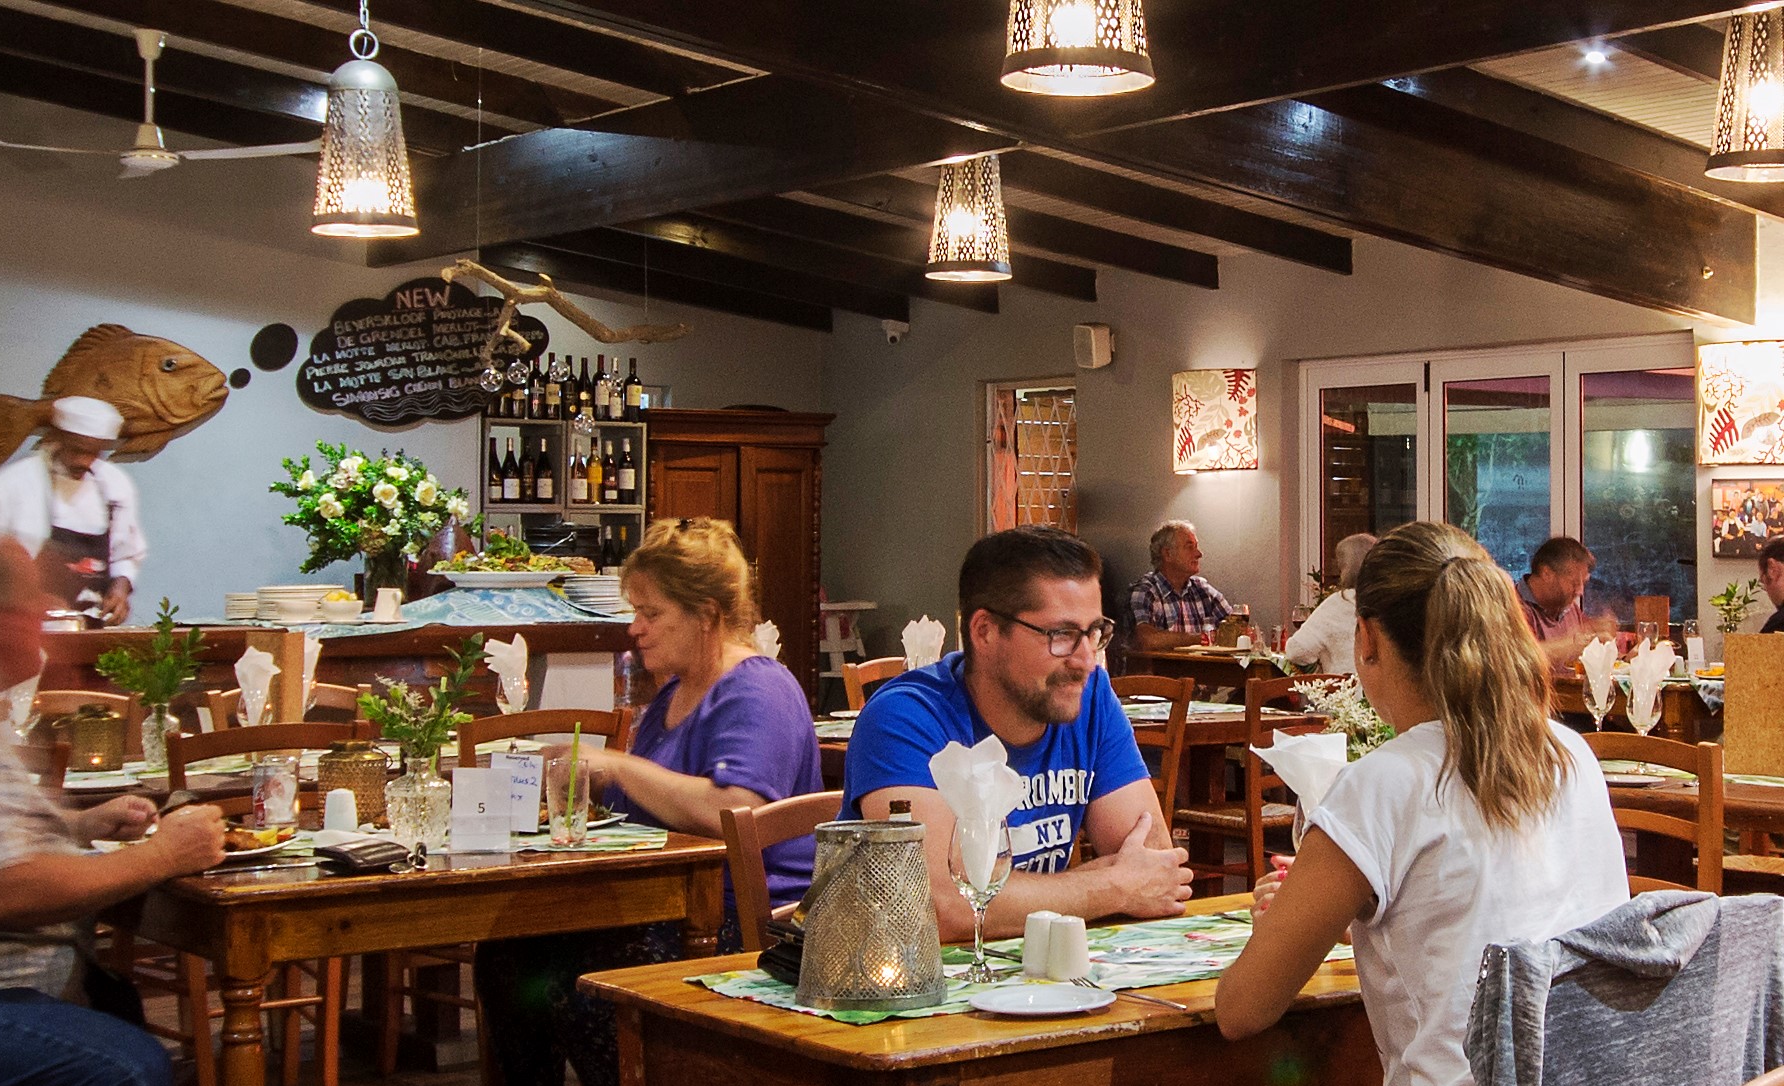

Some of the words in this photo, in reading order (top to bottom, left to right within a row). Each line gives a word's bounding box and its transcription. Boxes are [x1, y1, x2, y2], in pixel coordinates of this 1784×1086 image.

[396, 284, 452, 309] NEW
[336, 336, 355, 349] DE
[312, 353, 331, 365] LA
[313, 381, 333, 394] LA
[1016, 769, 1095, 811] ROMBI
[478, 802, 486, 814] 5
[1036, 818, 1065, 846] NY
